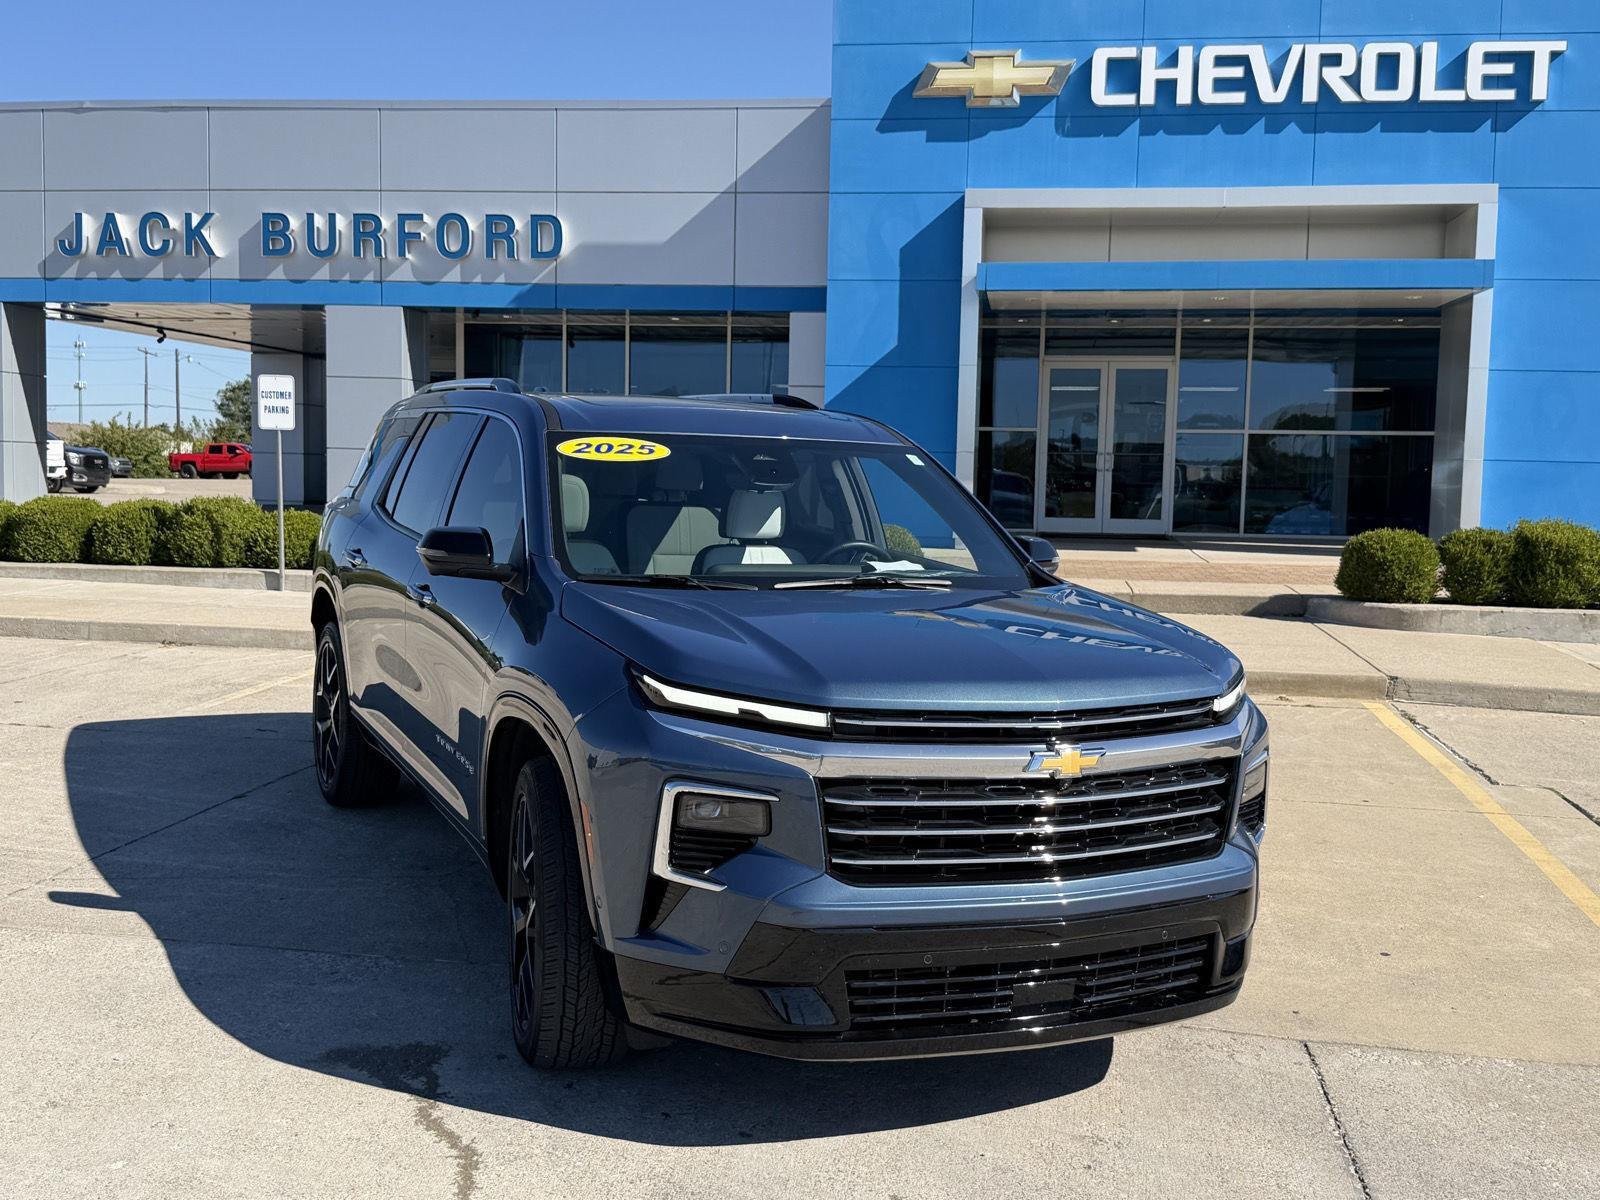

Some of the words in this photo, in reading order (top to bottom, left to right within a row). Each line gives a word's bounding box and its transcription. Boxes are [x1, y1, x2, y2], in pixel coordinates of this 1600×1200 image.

[1090, 40, 1568, 107] CHEVROLET
[57, 212, 218, 258] JACK
[261, 212, 564, 260] BURFORD
[260, 390, 292, 400] CUSTOMER
[263, 405, 290, 415] PARKING
[571, 442, 656, 456] 2025
